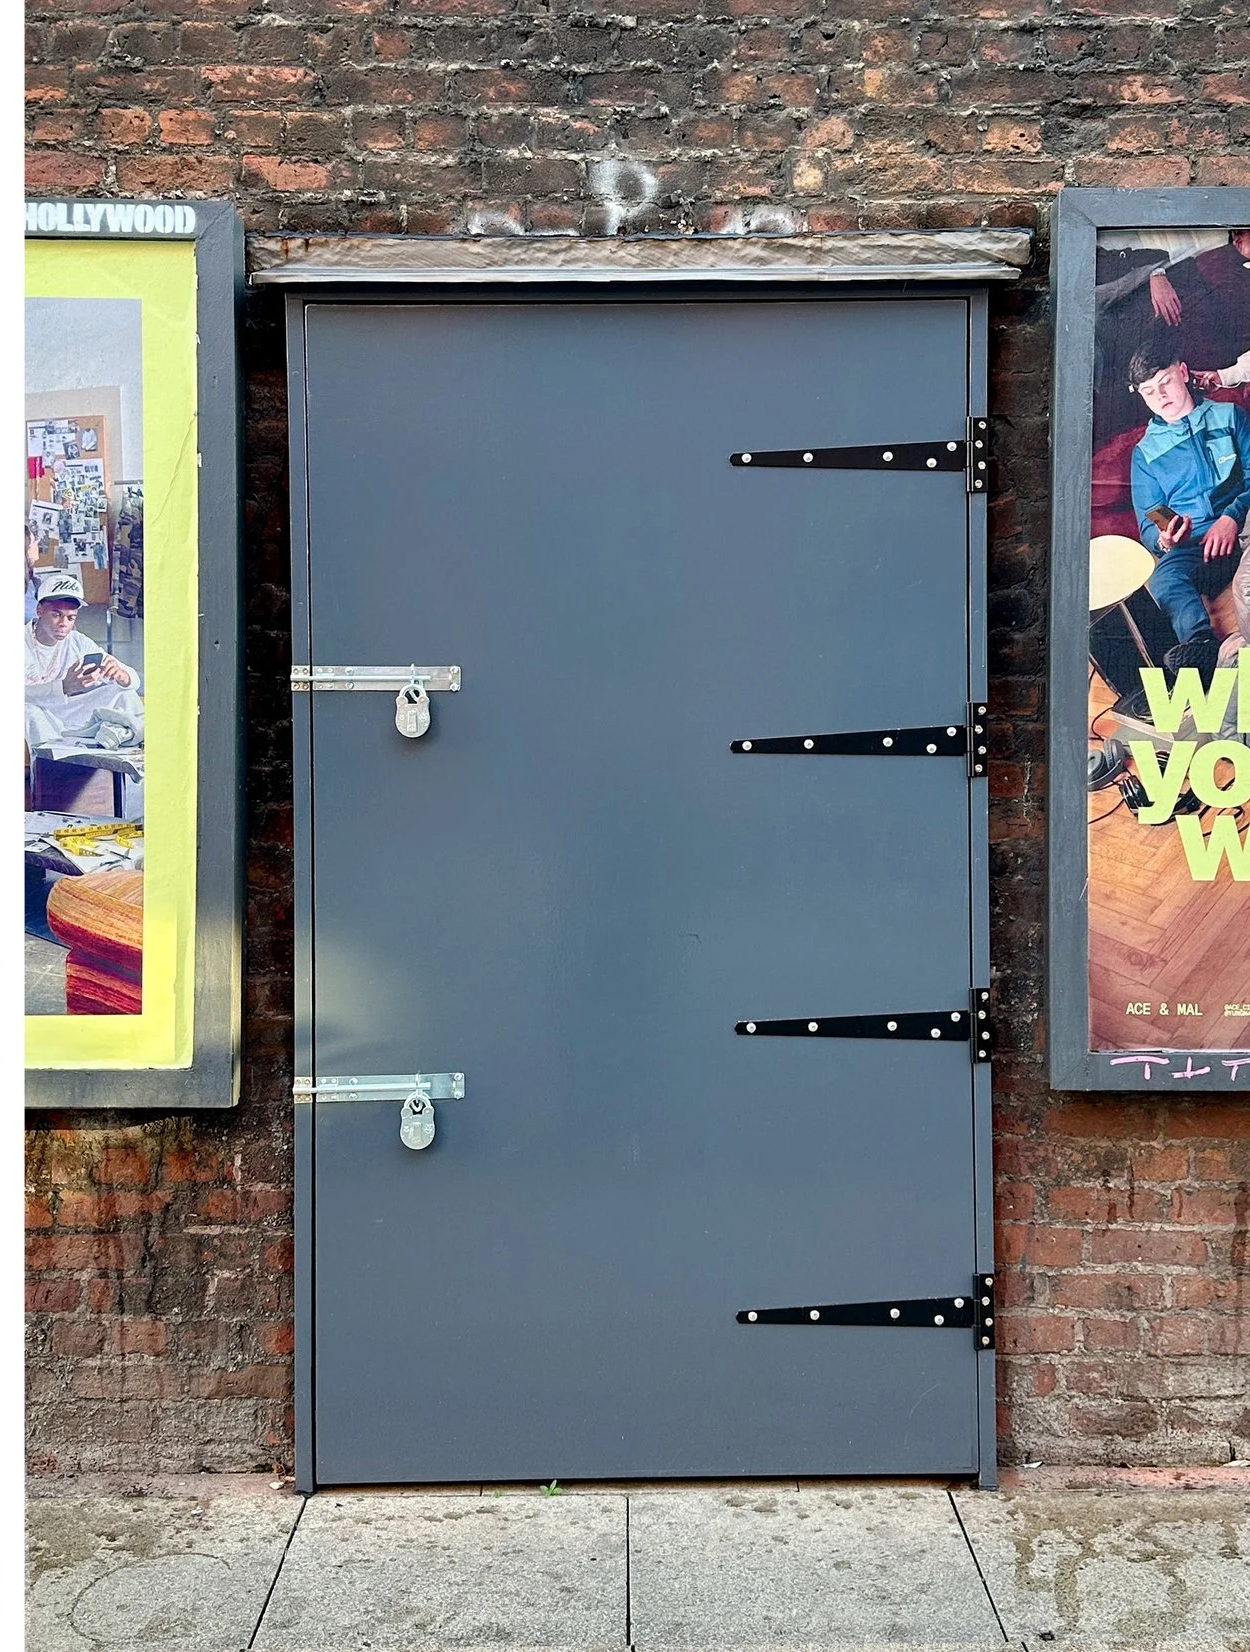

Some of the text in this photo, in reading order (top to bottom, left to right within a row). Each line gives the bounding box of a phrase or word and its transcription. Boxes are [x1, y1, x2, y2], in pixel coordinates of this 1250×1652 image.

[1126, 1002, 1203, 1016] ACE & MAL
